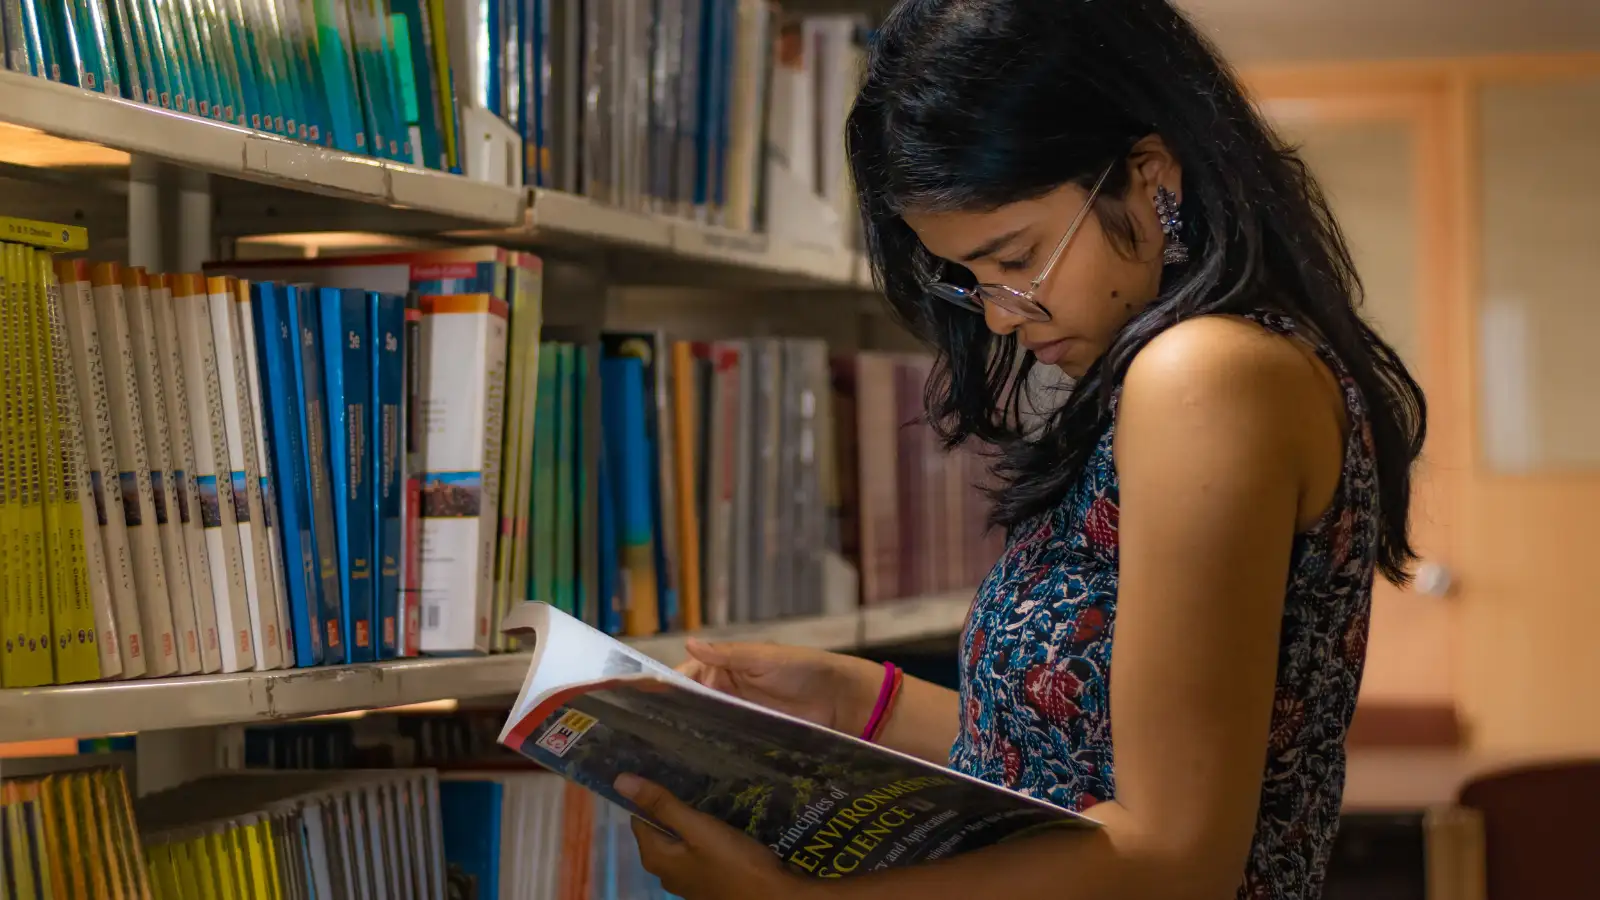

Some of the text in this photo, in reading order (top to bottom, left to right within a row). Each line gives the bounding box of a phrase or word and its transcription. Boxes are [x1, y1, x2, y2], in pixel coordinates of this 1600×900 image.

[768, 784, 849, 858] Principles of
[818, 805, 915, 878] SCIENCE
[886, 841, 908, 862] and
[901, 808, 959, 847] Applications
